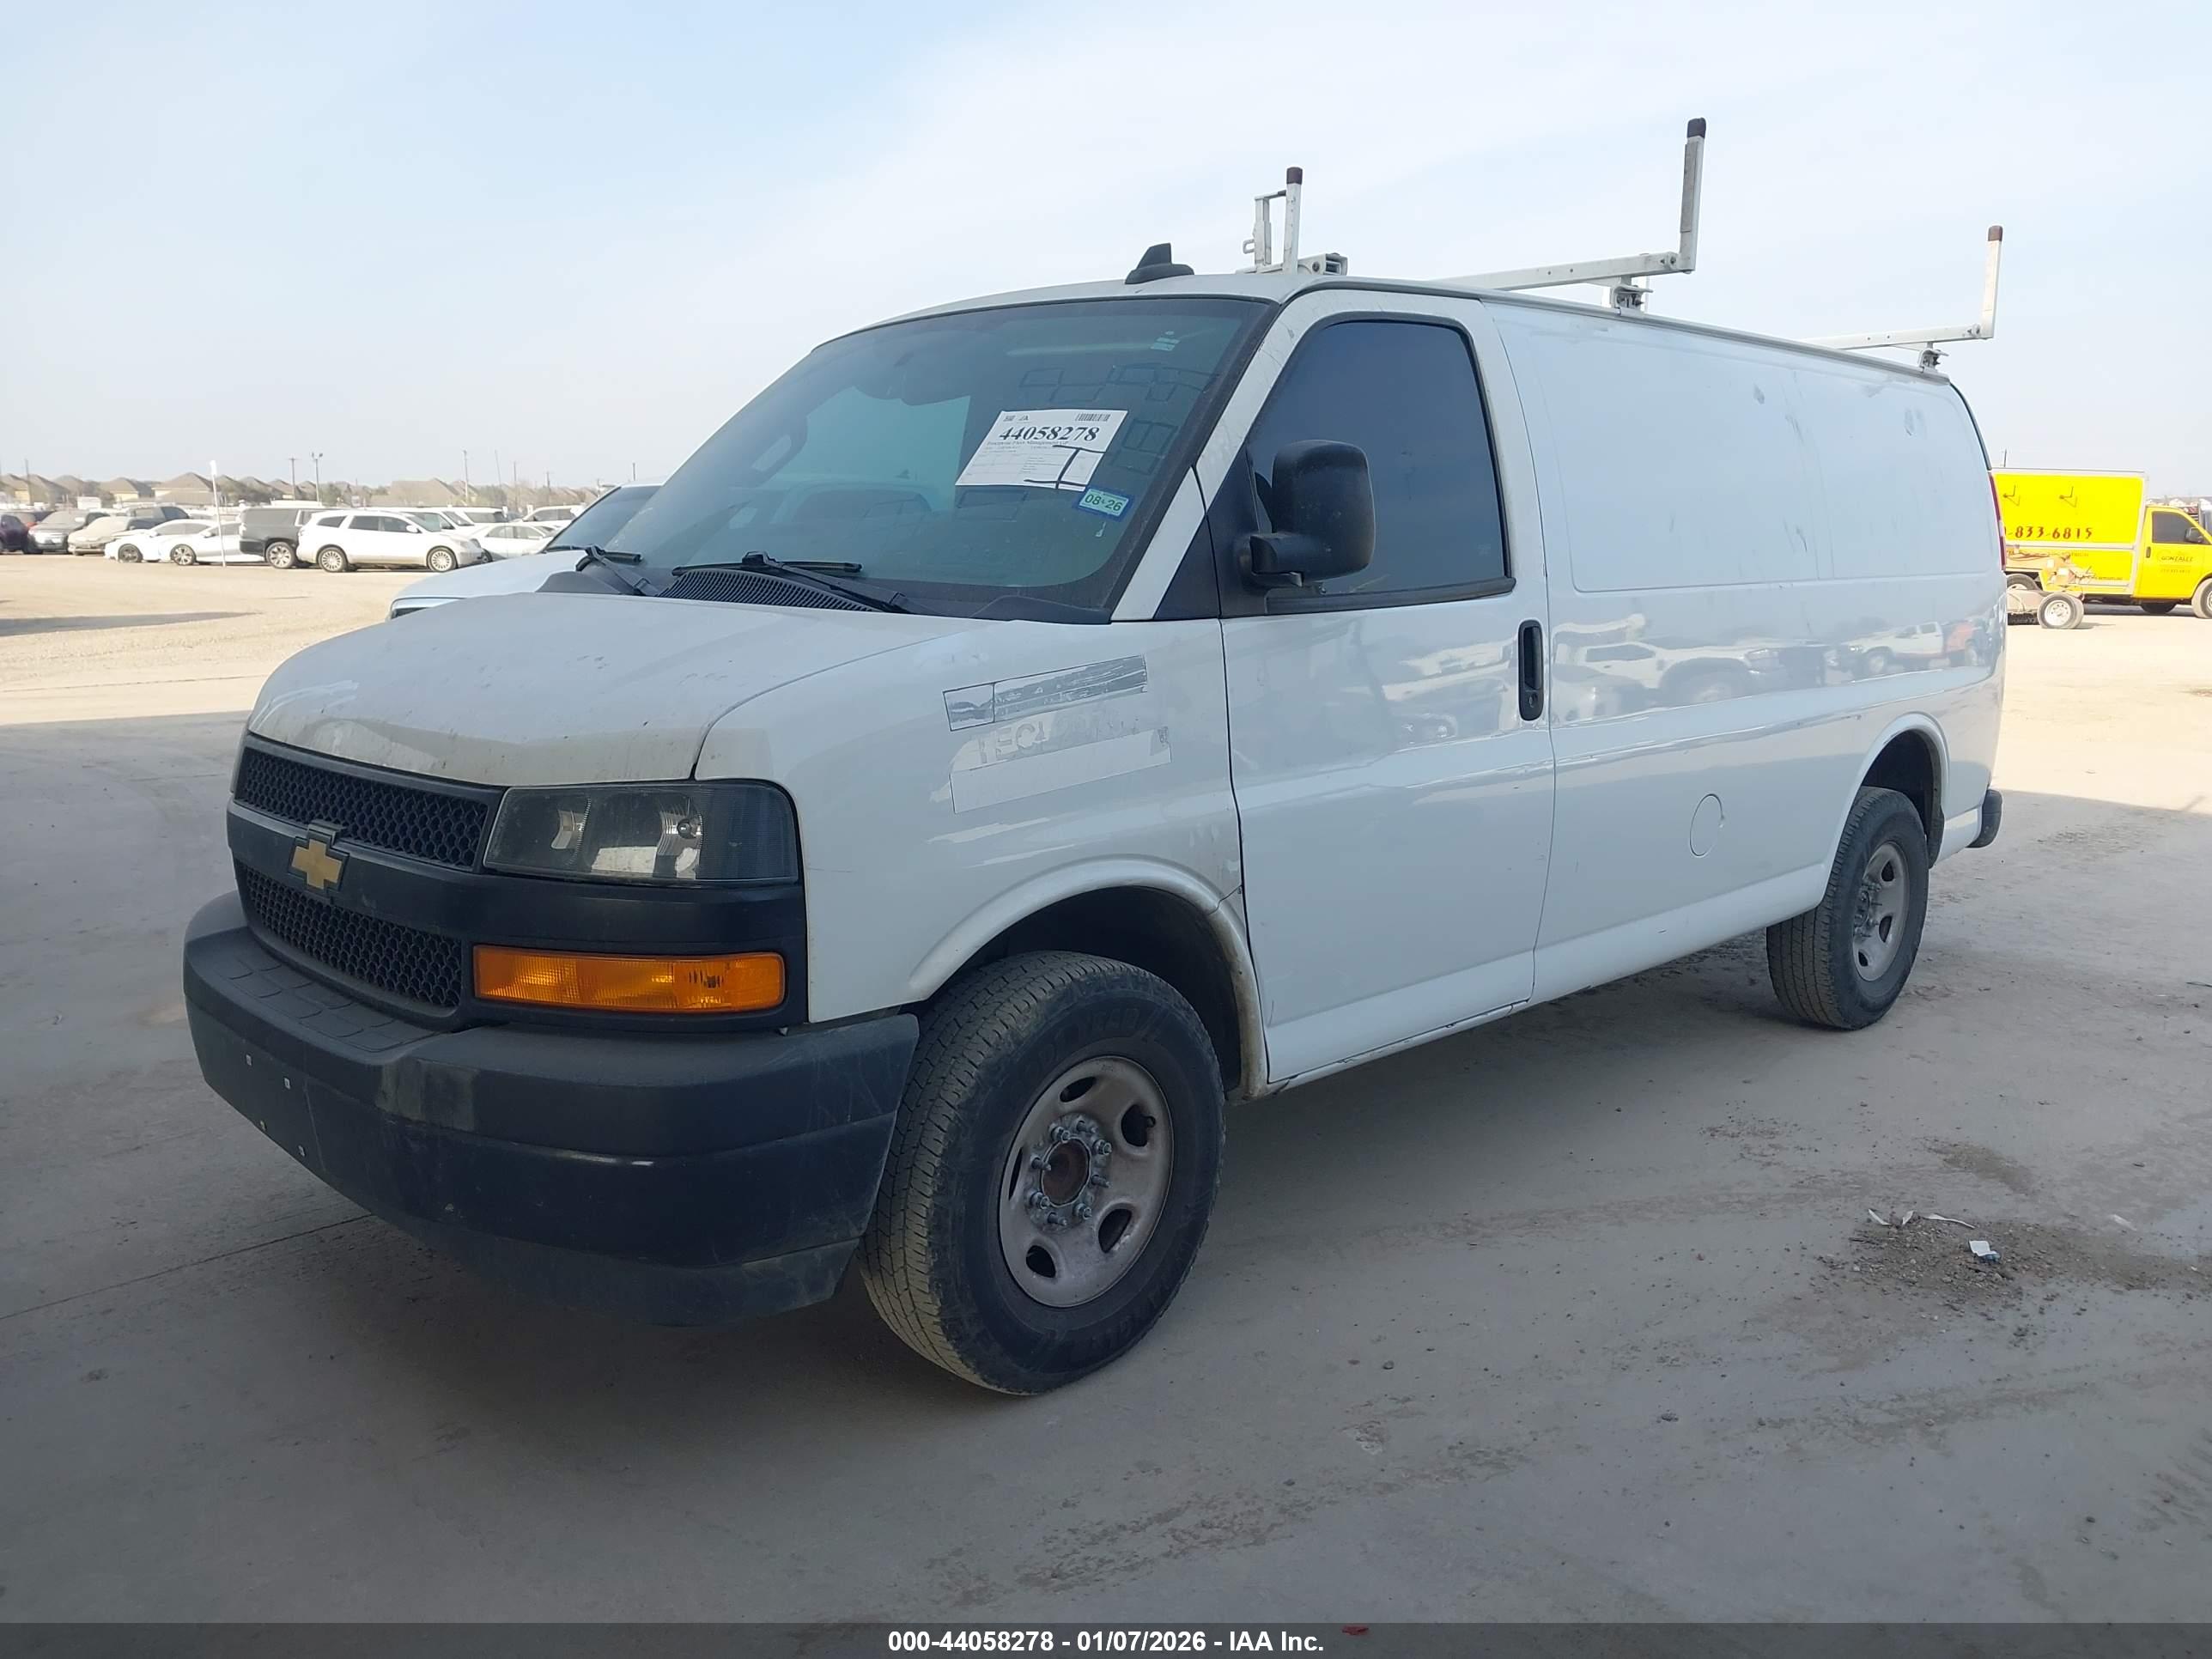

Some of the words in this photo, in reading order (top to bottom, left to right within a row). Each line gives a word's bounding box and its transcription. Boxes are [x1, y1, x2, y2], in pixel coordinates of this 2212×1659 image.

[999, 425, 1100, 441] 44058278
[1085, 494, 1102, 505] 08
[1105, 499, 1123, 511] 26
